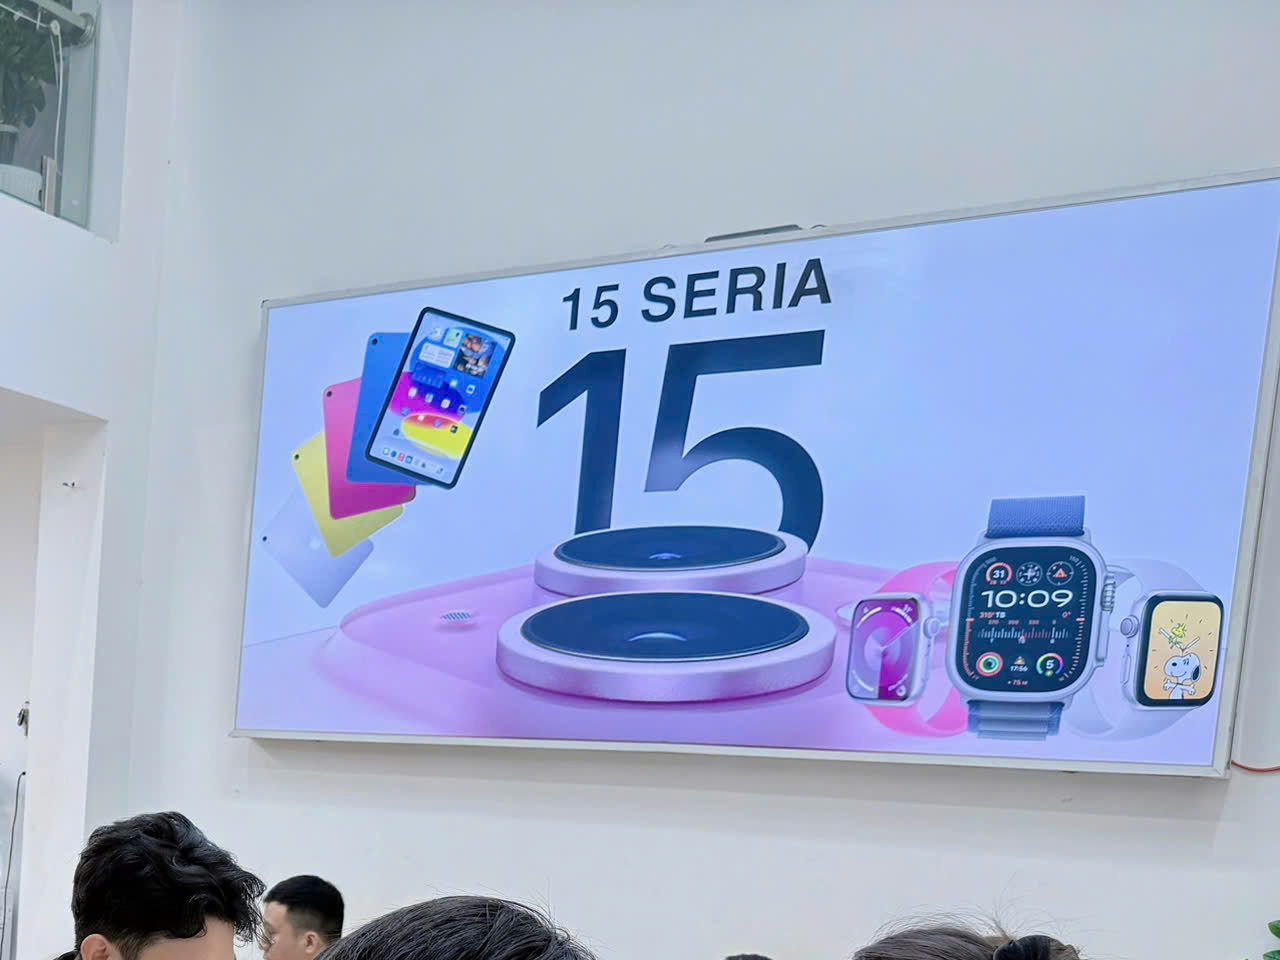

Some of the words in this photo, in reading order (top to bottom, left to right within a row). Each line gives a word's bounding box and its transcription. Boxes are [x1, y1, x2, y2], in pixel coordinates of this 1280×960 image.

[562, 284, 620, 331] 15
[641, 258, 832, 323] SERIA
[536, 329, 826, 554] 15
[992, 570, 1005, 578] 31
[981, 589, 1073, 608] 10:09
